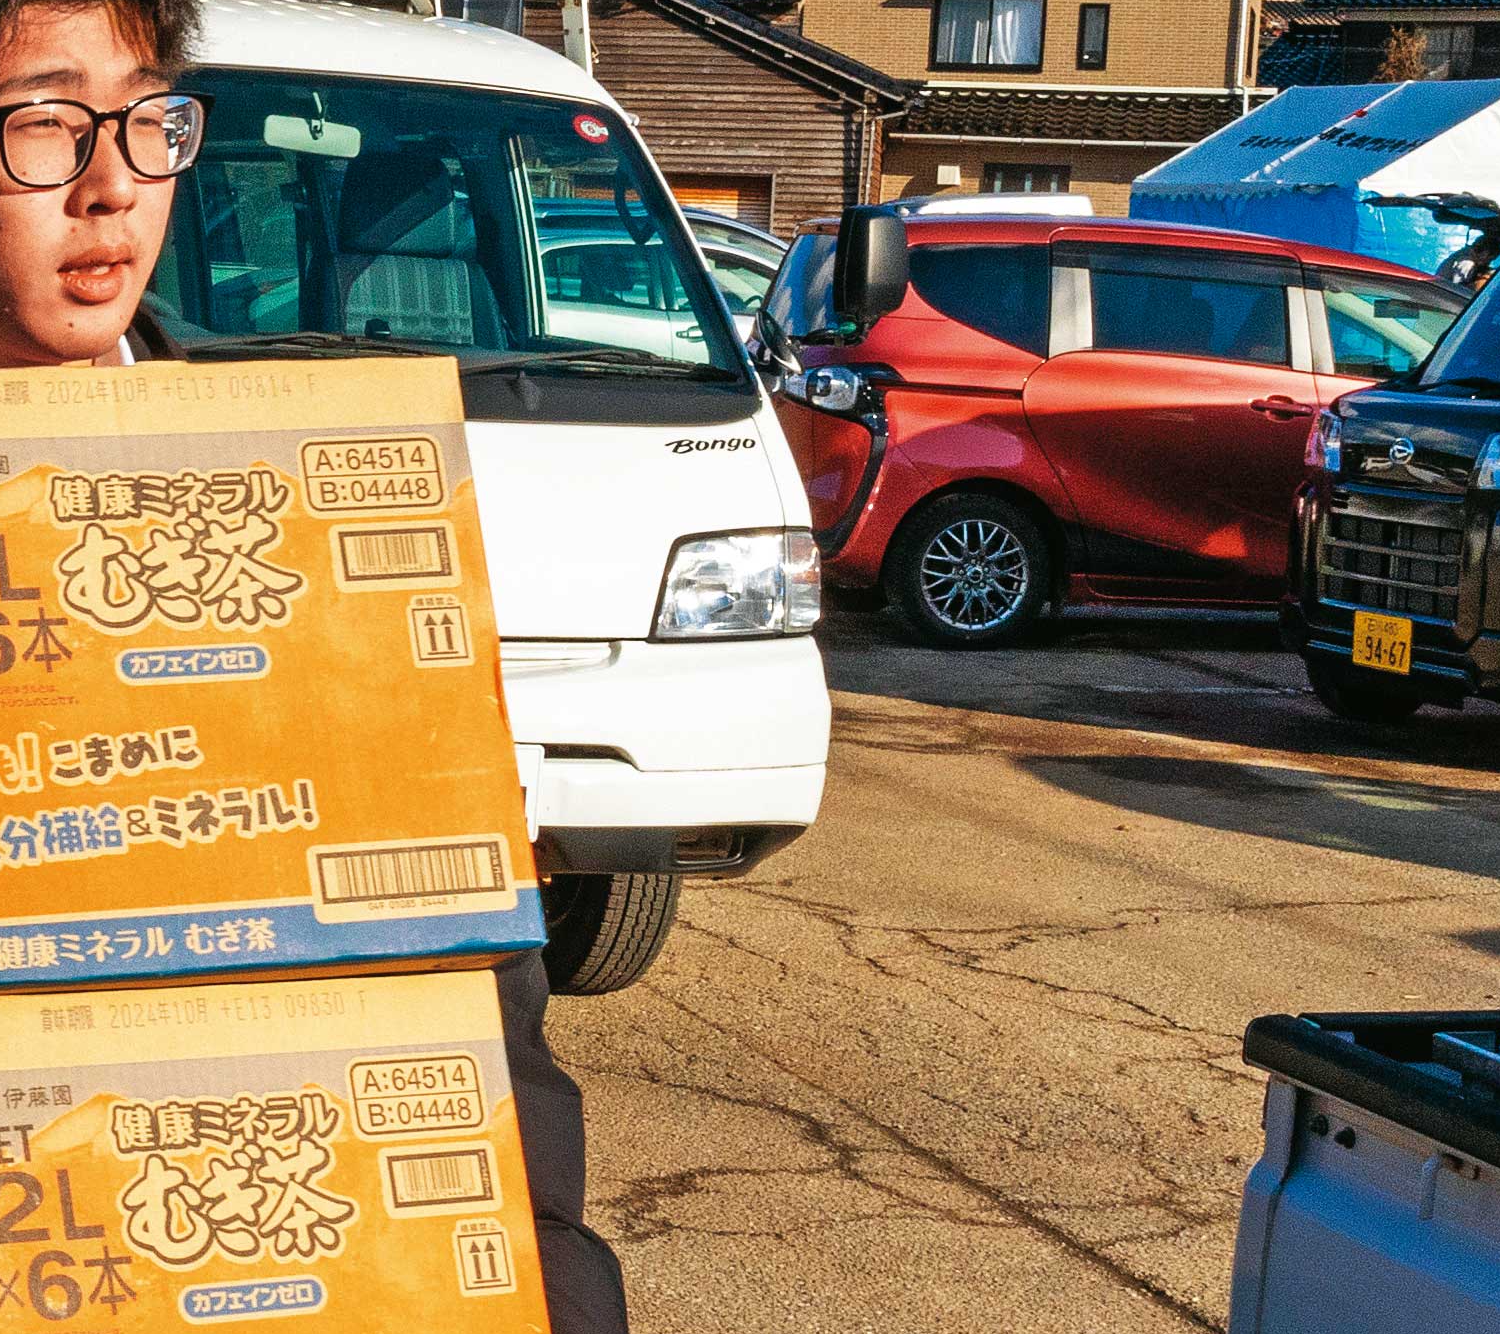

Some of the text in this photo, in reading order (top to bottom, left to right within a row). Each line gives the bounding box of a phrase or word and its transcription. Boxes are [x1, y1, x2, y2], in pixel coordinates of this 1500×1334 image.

[315, 444, 426, 473] A:64514
[664, 435, 756, 455] Bongo
[50, 471, 290, 523] 健康ミネラル
[320, 477, 431, 504] B:04448
[58, 513, 304, 628] むぎ茶
[128, 650, 258, 675] カフェインゼロ
[1365, 635, 1406, 668] 94-67
[53, 728, 198, 780] こまめに
[184, 916, 276, 955] むぎ茶
[363, 1063, 467, 1094] A:64514
[3, 1085, 72, 1109] 伊藤園
[367, 1097, 472, 1127] B:04448
[111, 1093, 340, 1153] 健康ミネラル
[122, 1139, 356, 1265] むぎ茶
[193, 1283, 314, 1312] カフェインゼロ
